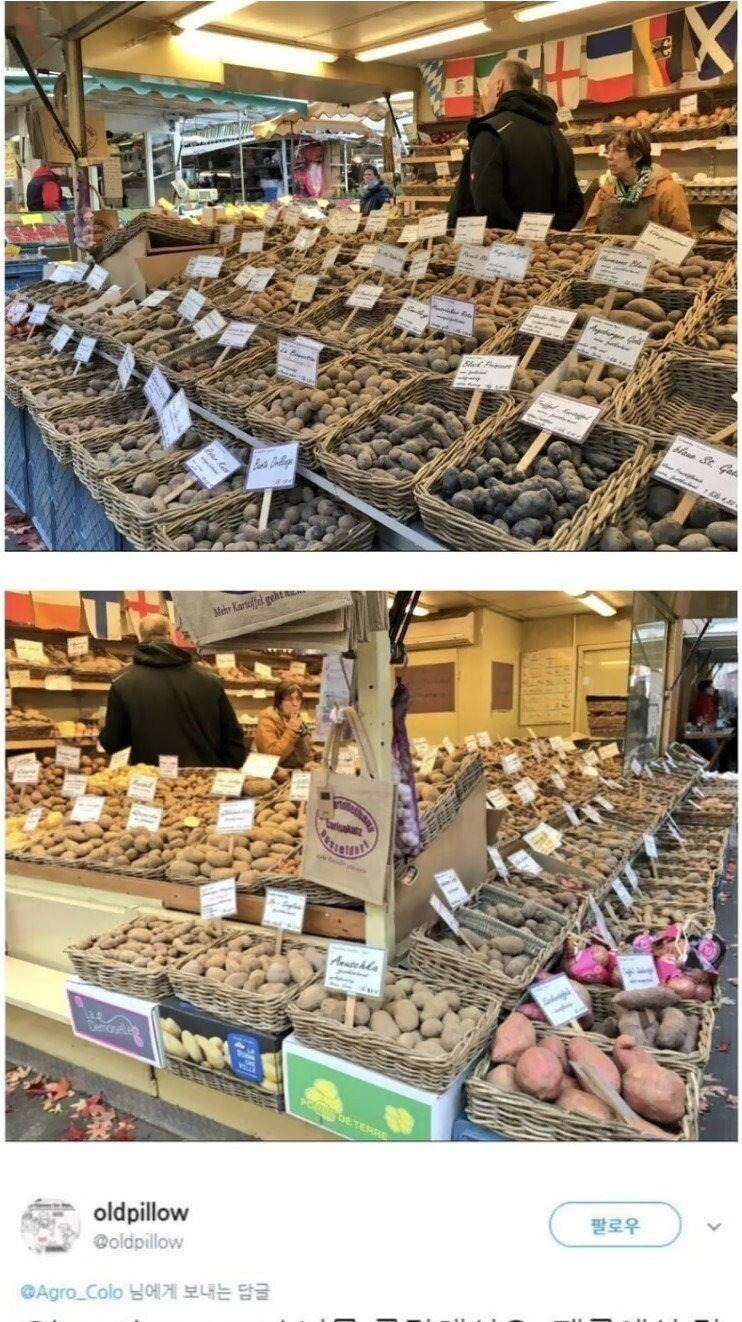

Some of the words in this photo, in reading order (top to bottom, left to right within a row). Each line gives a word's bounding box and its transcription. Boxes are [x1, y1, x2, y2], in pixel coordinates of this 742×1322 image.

[232, 594, 265, 610] Kartoffel
[329, 954, 379, 972] Anuschka
[338, 1114, 353, 1127] DE
[353, 1119, 389, 1142] TERRE
[93, 1200, 190, 1226] oldpillow
[591, 1217, 640, 1236] 팔로우
[93, 1233, 184, 1251] @oldpillow
[20, 1284, 123, 1302] @Agro_Colo
[129, 1284, 178, 1301] 님에게
[183, 1284, 232, 1301] 보내는
[238, 1284, 271, 1301] 답글
